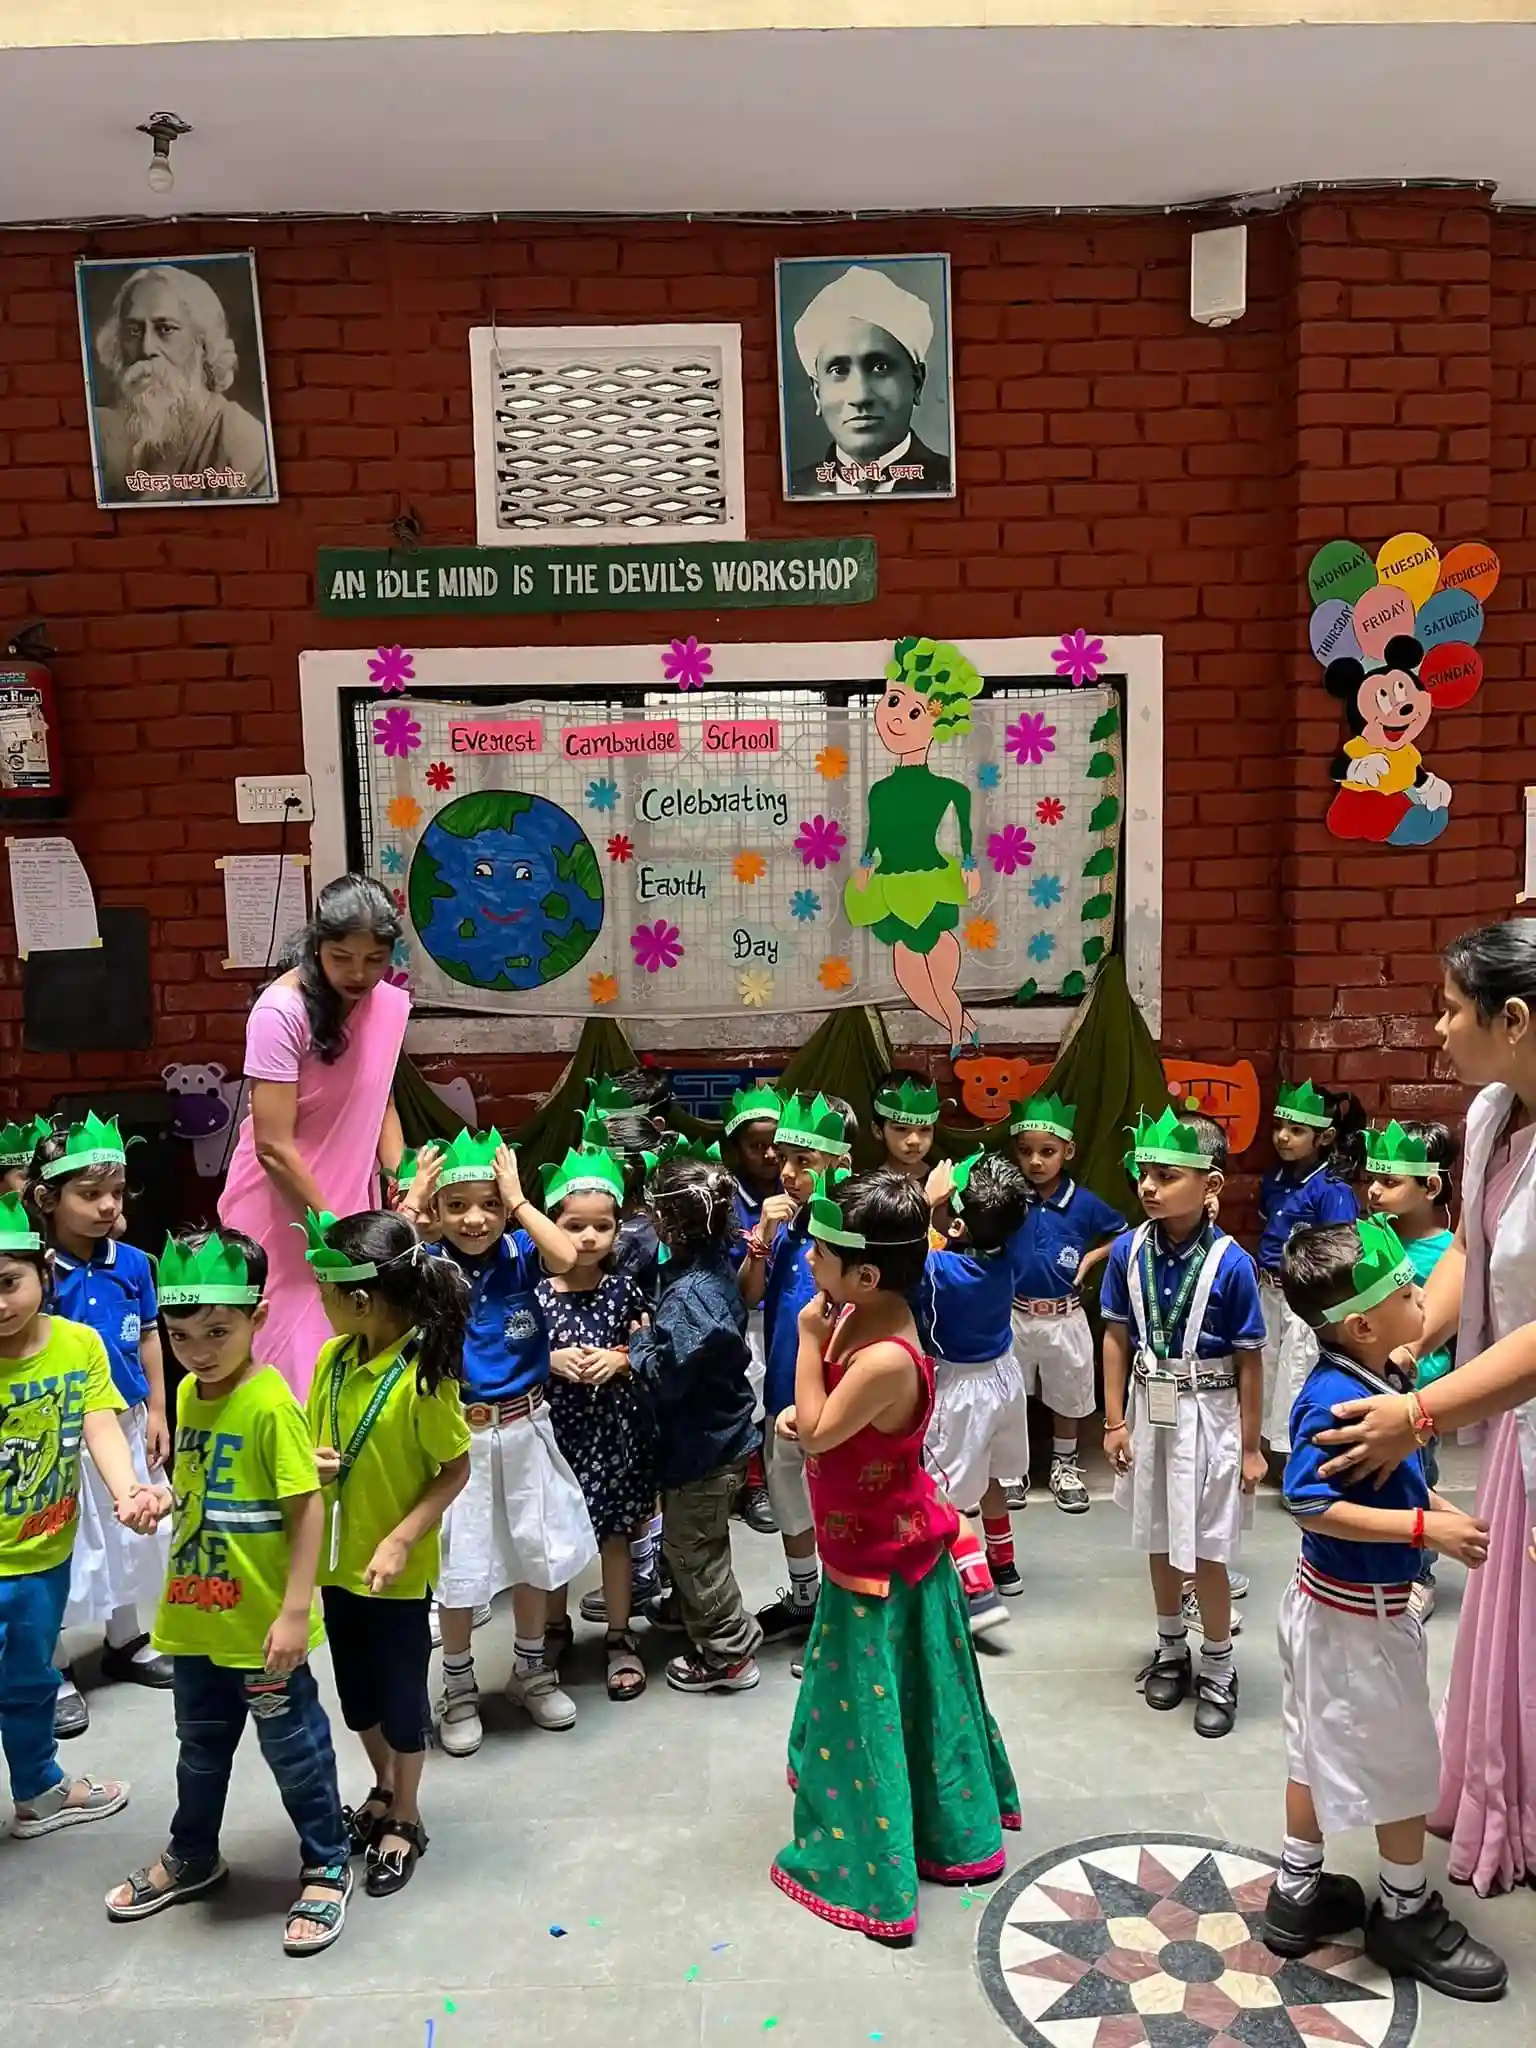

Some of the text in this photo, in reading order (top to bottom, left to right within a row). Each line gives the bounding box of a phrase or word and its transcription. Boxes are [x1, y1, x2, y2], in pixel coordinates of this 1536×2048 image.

[172, 473, 205, 490] नाथ
[330, 556, 858, 600] AN IDLE MIND IS THE DEVIL'S WORKSHOP
[1313, 551, 1368, 592] MONDAY
[1381, 546, 1438, 580] TUESDAY
[1441, 557, 1499, 589] WEDNESDAY
[1316, 605, 1355, 657] THURSDAY
[1362, 600, 1409, 633] FRIDAY
[1423, 603, 1483, 636] SATURDAY
[1428, 660, 1478, 688] SUNDAY
[451, 724, 773, 756] Everest Cambridge School
[641, 784, 789, 826] Celebrating
[640, 866, 706, 899] Earth
[732, 928, 778, 965] Day
[180, 1291, 200, 1304] Day
